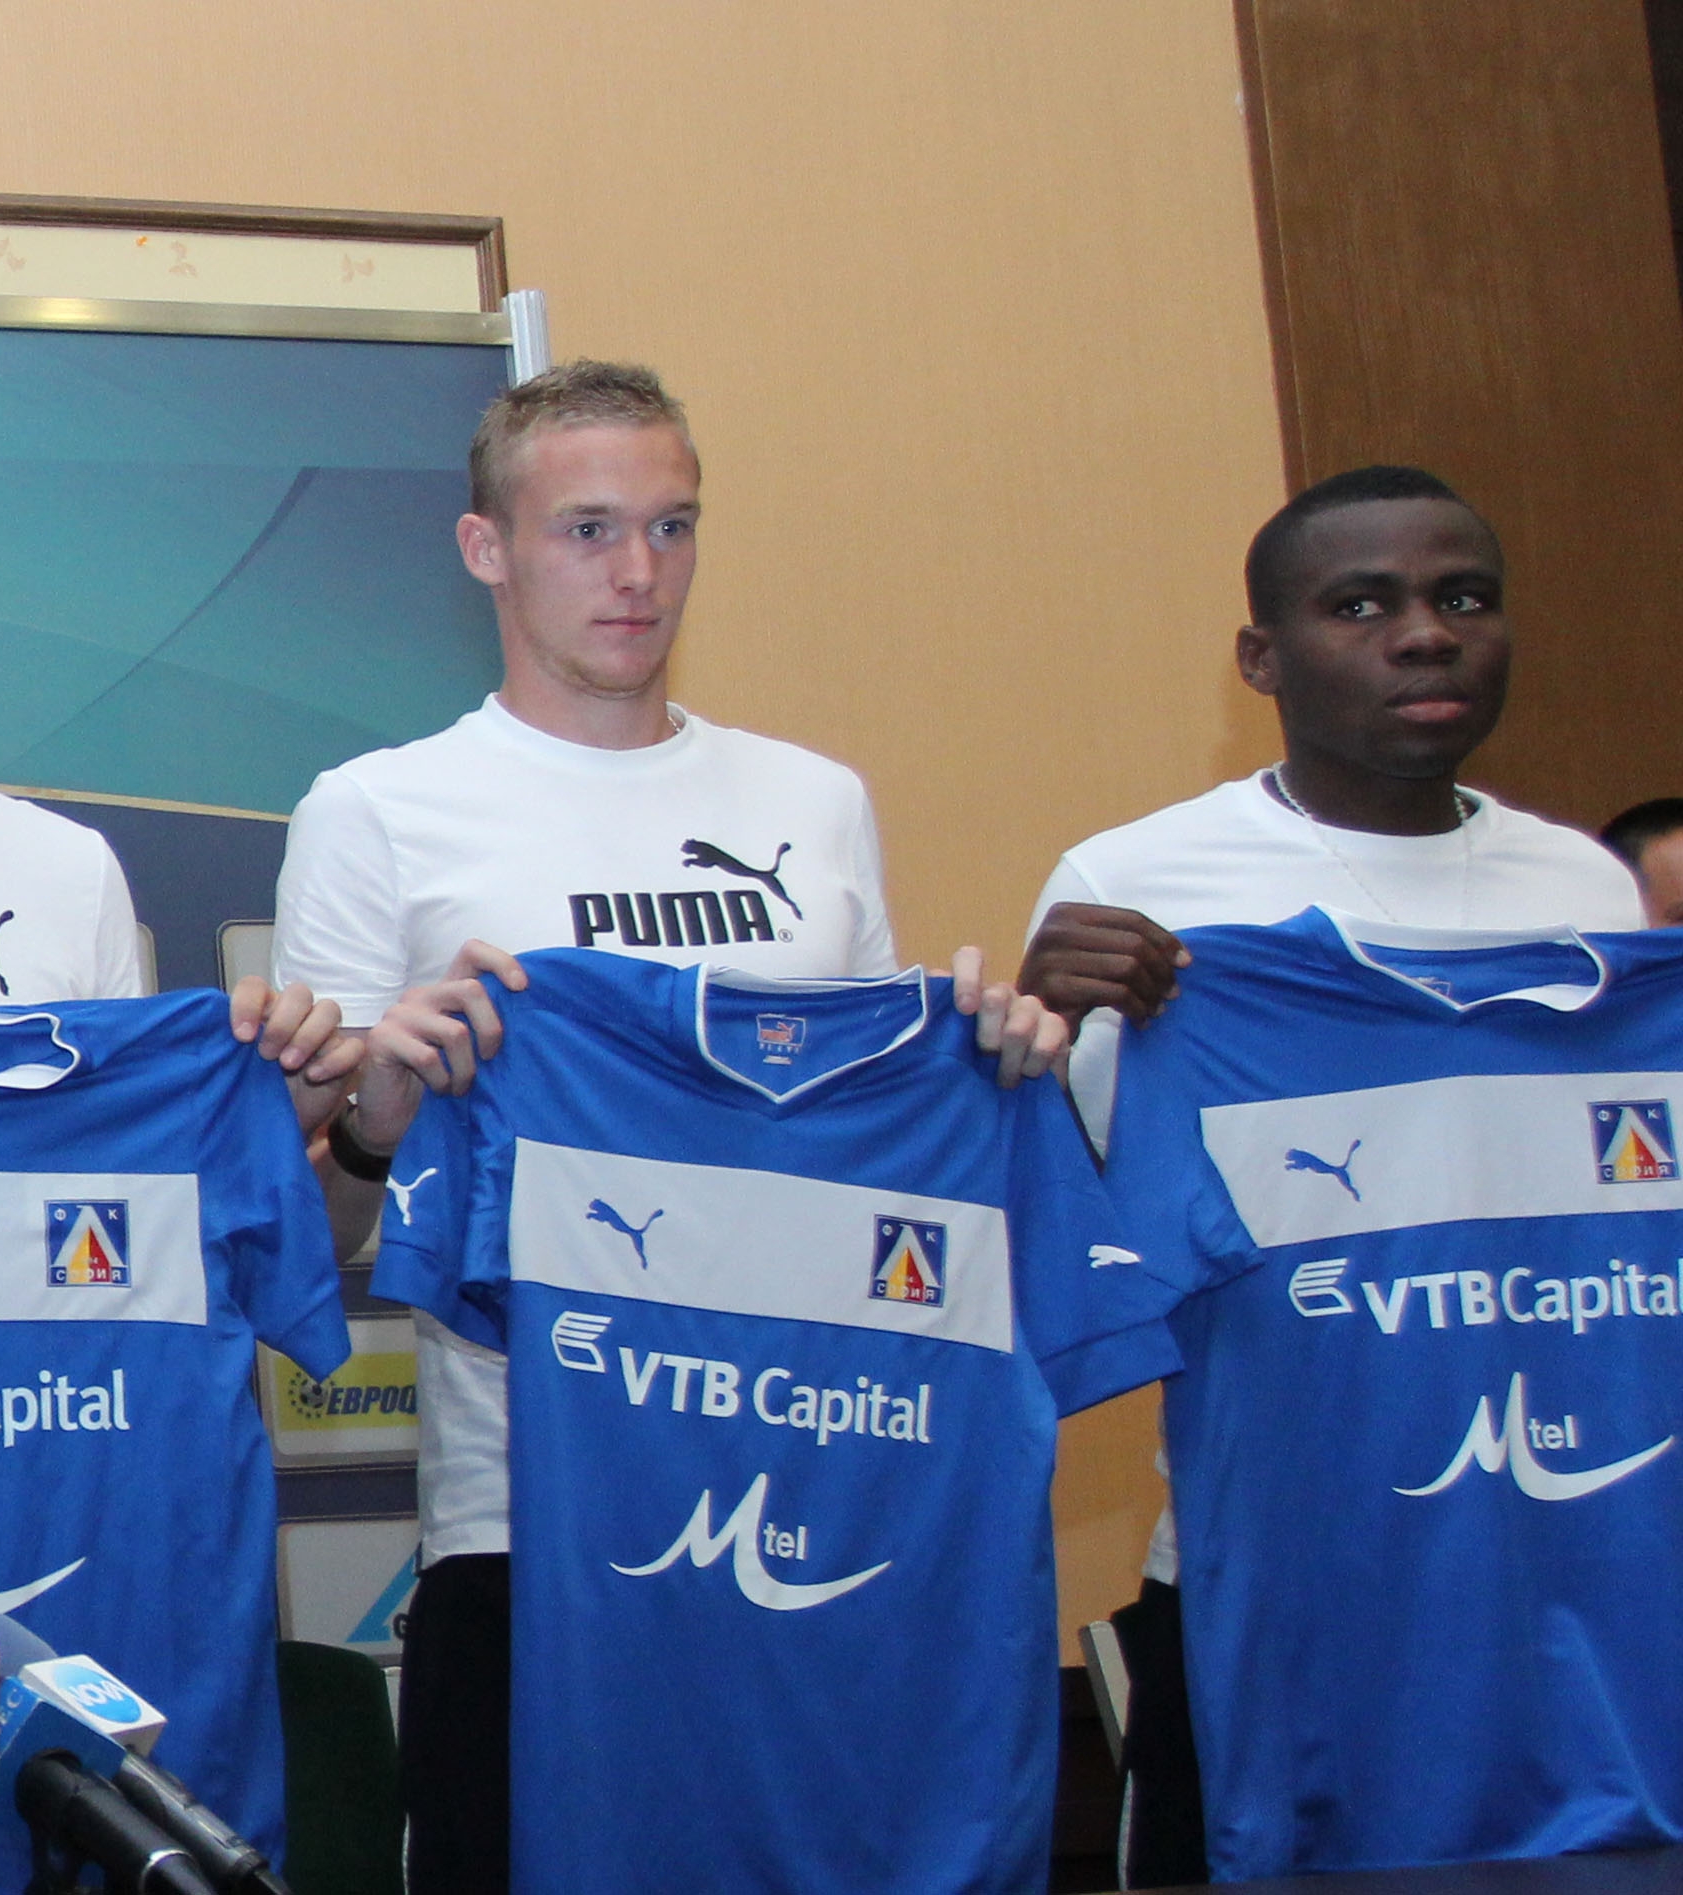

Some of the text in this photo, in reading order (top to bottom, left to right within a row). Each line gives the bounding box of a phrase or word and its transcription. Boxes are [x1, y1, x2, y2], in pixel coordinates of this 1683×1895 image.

[568, 890, 775, 947] PUMA
[1361, 1270, 1497, 1334] VTB
[618, 1348, 930, 1446] VTB Capital
